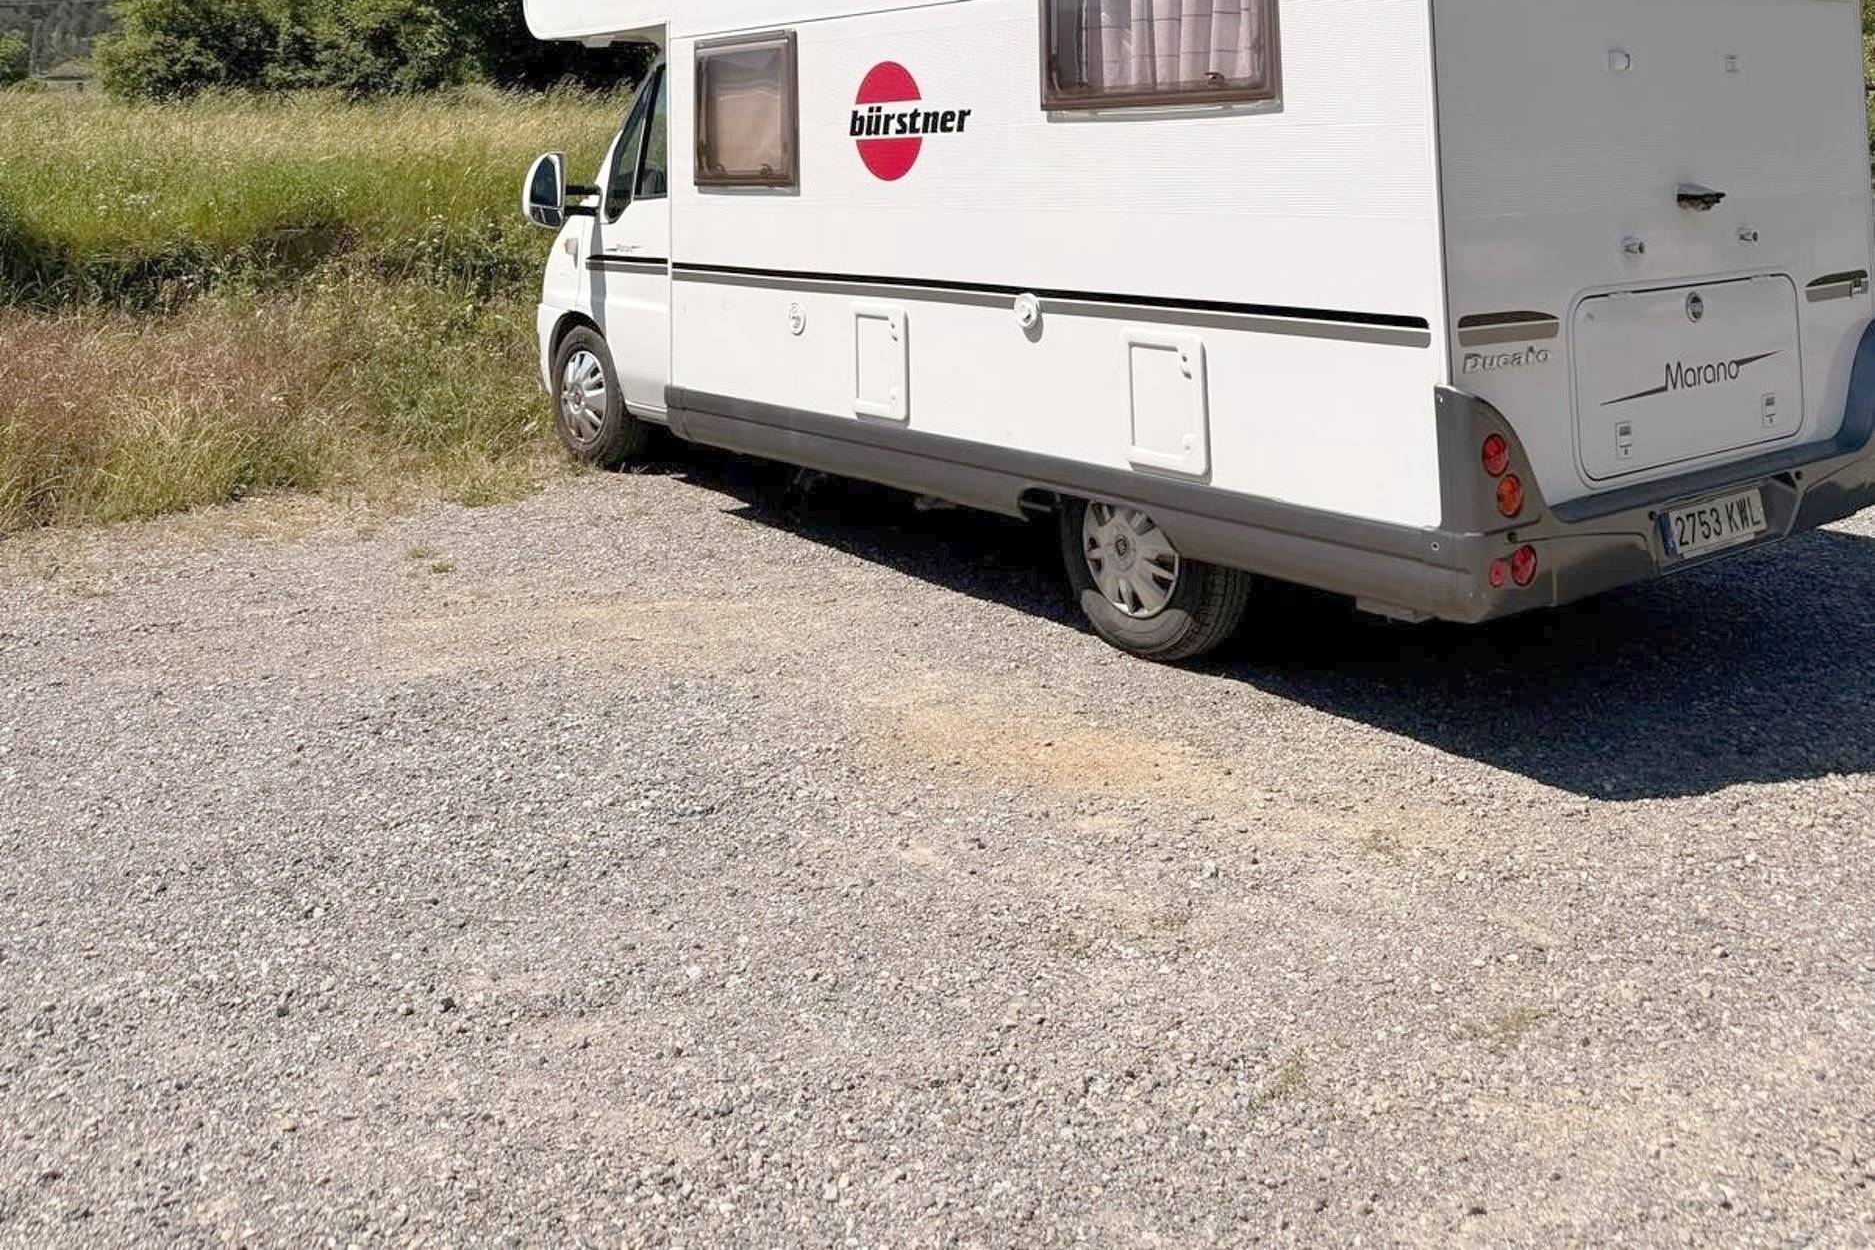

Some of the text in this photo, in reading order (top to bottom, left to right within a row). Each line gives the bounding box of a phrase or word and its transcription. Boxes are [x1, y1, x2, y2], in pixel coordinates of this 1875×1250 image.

[850, 106, 971, 136] bürstner
[1462, 346, 1549, 374] Ducato
[1665, 359, 1740, 390] Marano
[1675, 508, 1722, 546] 2753
[1725, 497, 1760, 531] KWL
